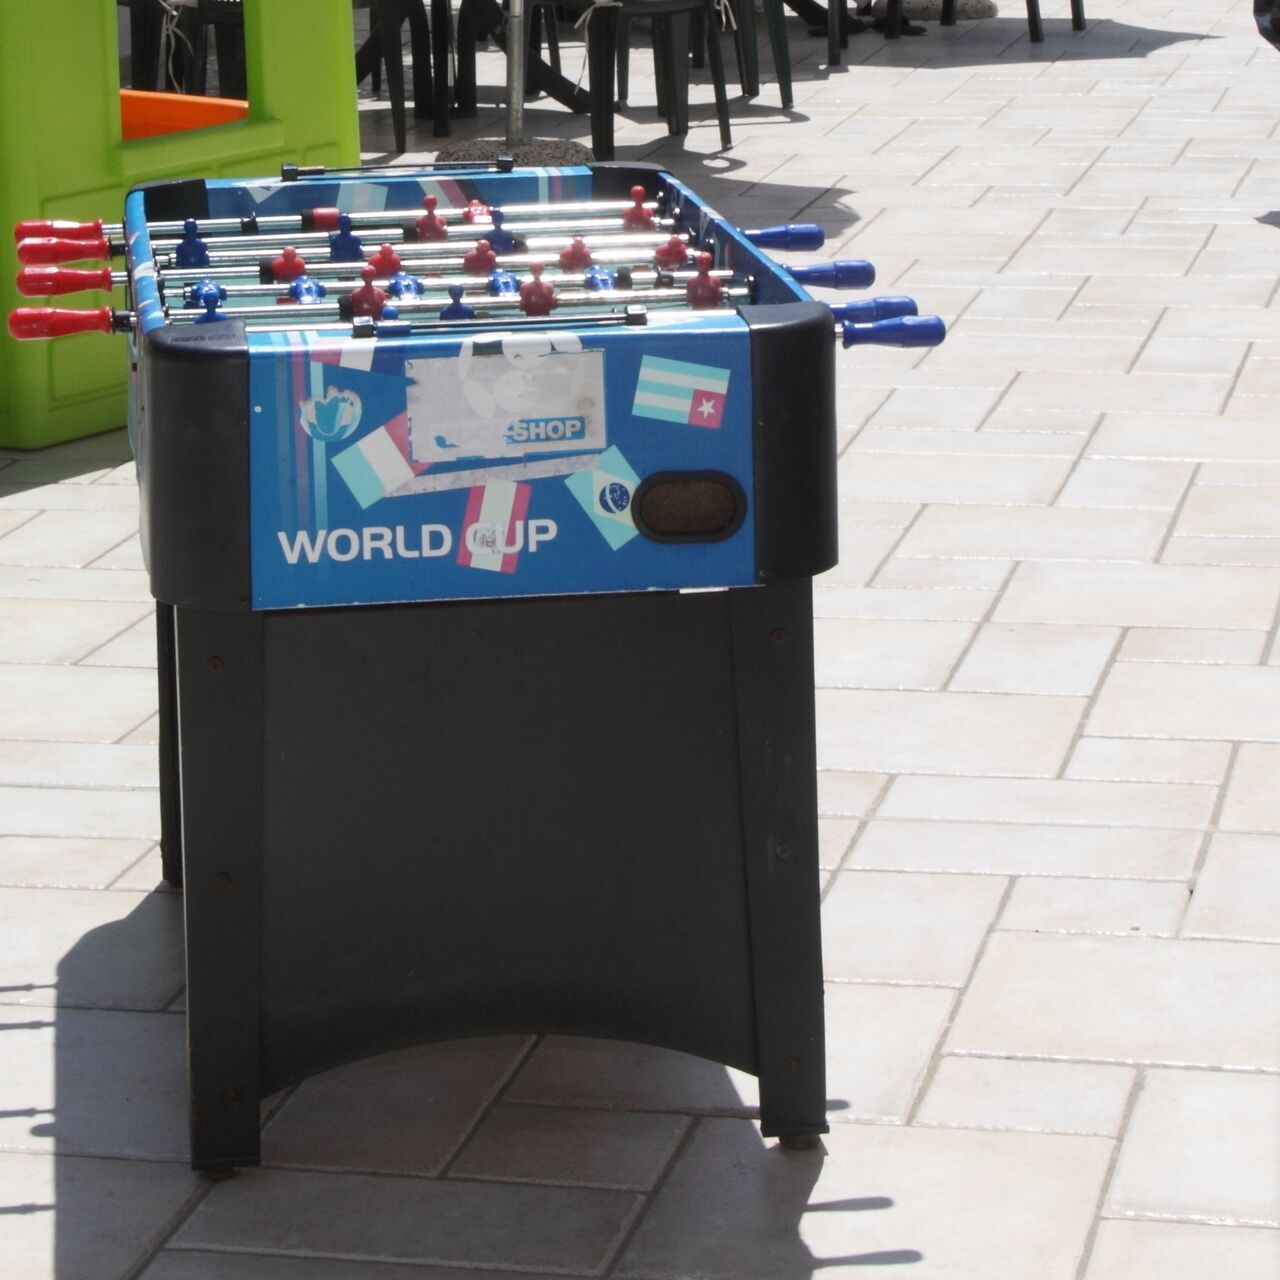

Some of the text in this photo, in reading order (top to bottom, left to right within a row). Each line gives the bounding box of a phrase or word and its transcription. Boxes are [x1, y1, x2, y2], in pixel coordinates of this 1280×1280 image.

[511, 419, 583, 441] SHOP
[276, 518, 559, 565] WORLD CUP
